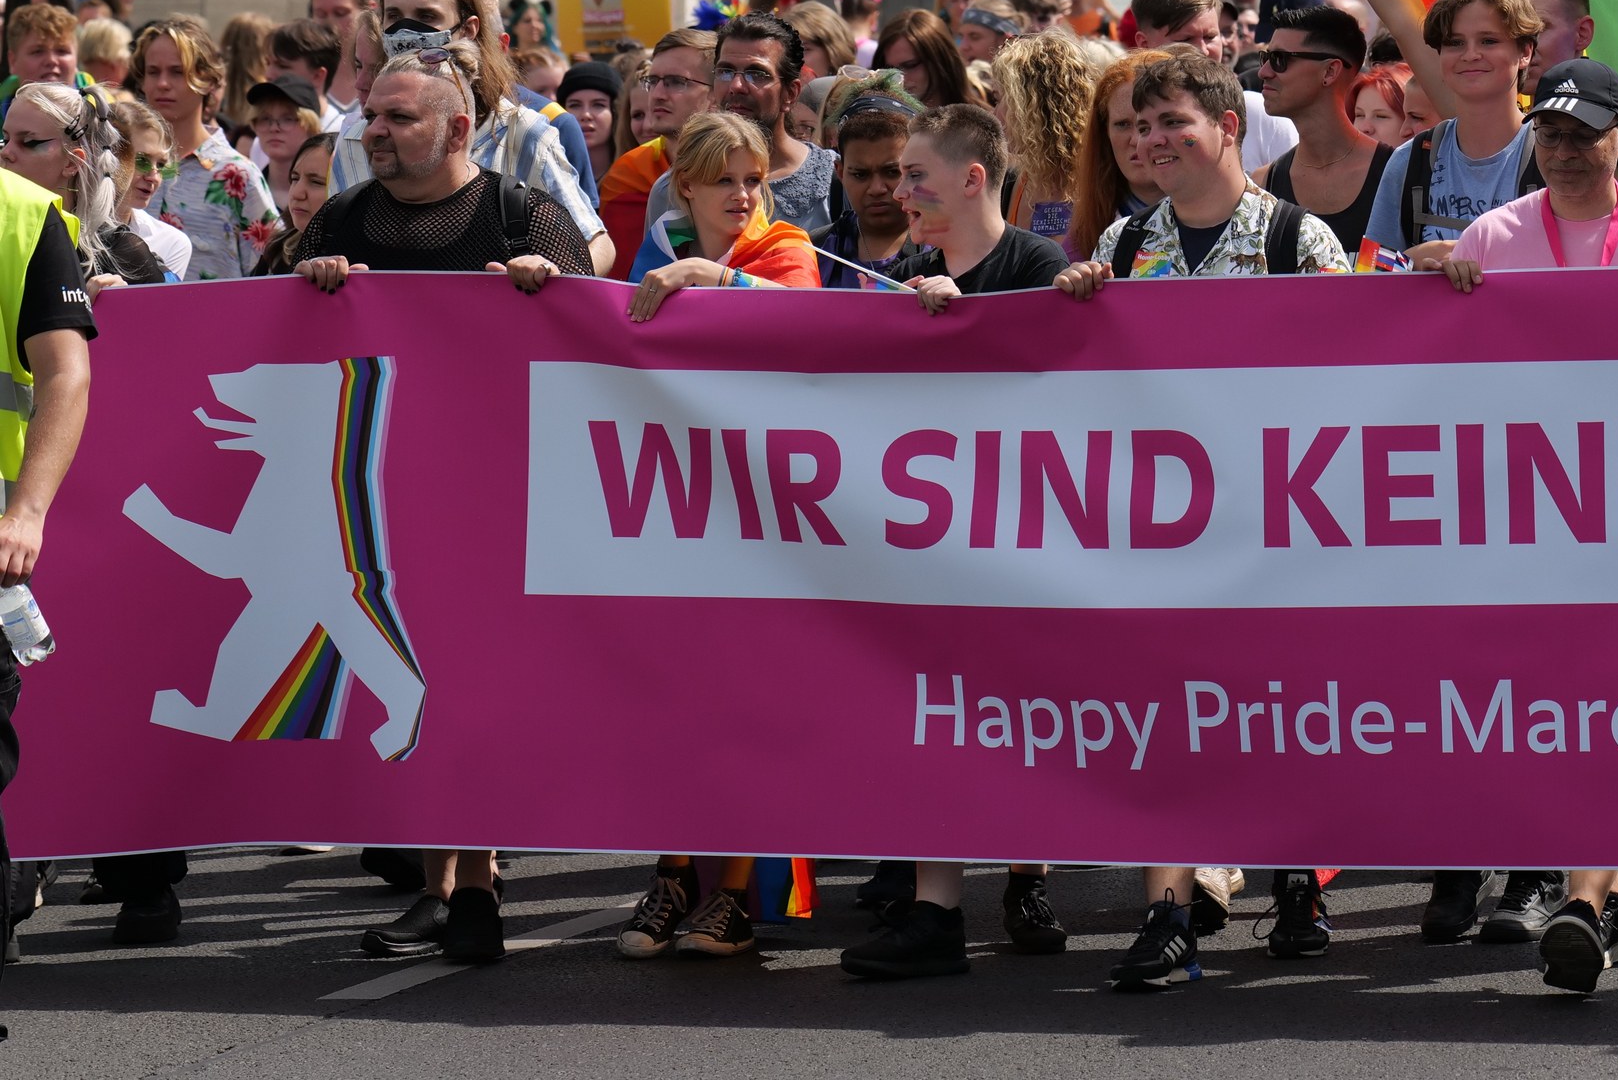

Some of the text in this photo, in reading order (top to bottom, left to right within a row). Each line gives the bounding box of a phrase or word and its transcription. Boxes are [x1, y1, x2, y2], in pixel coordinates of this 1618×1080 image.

[1043, 206, 1063, 214] GEGEN
[588, 421, 847, 547] WIR
[882, 430, 1214, 549] SIND
[913, 673, 1160, 771] Happy
